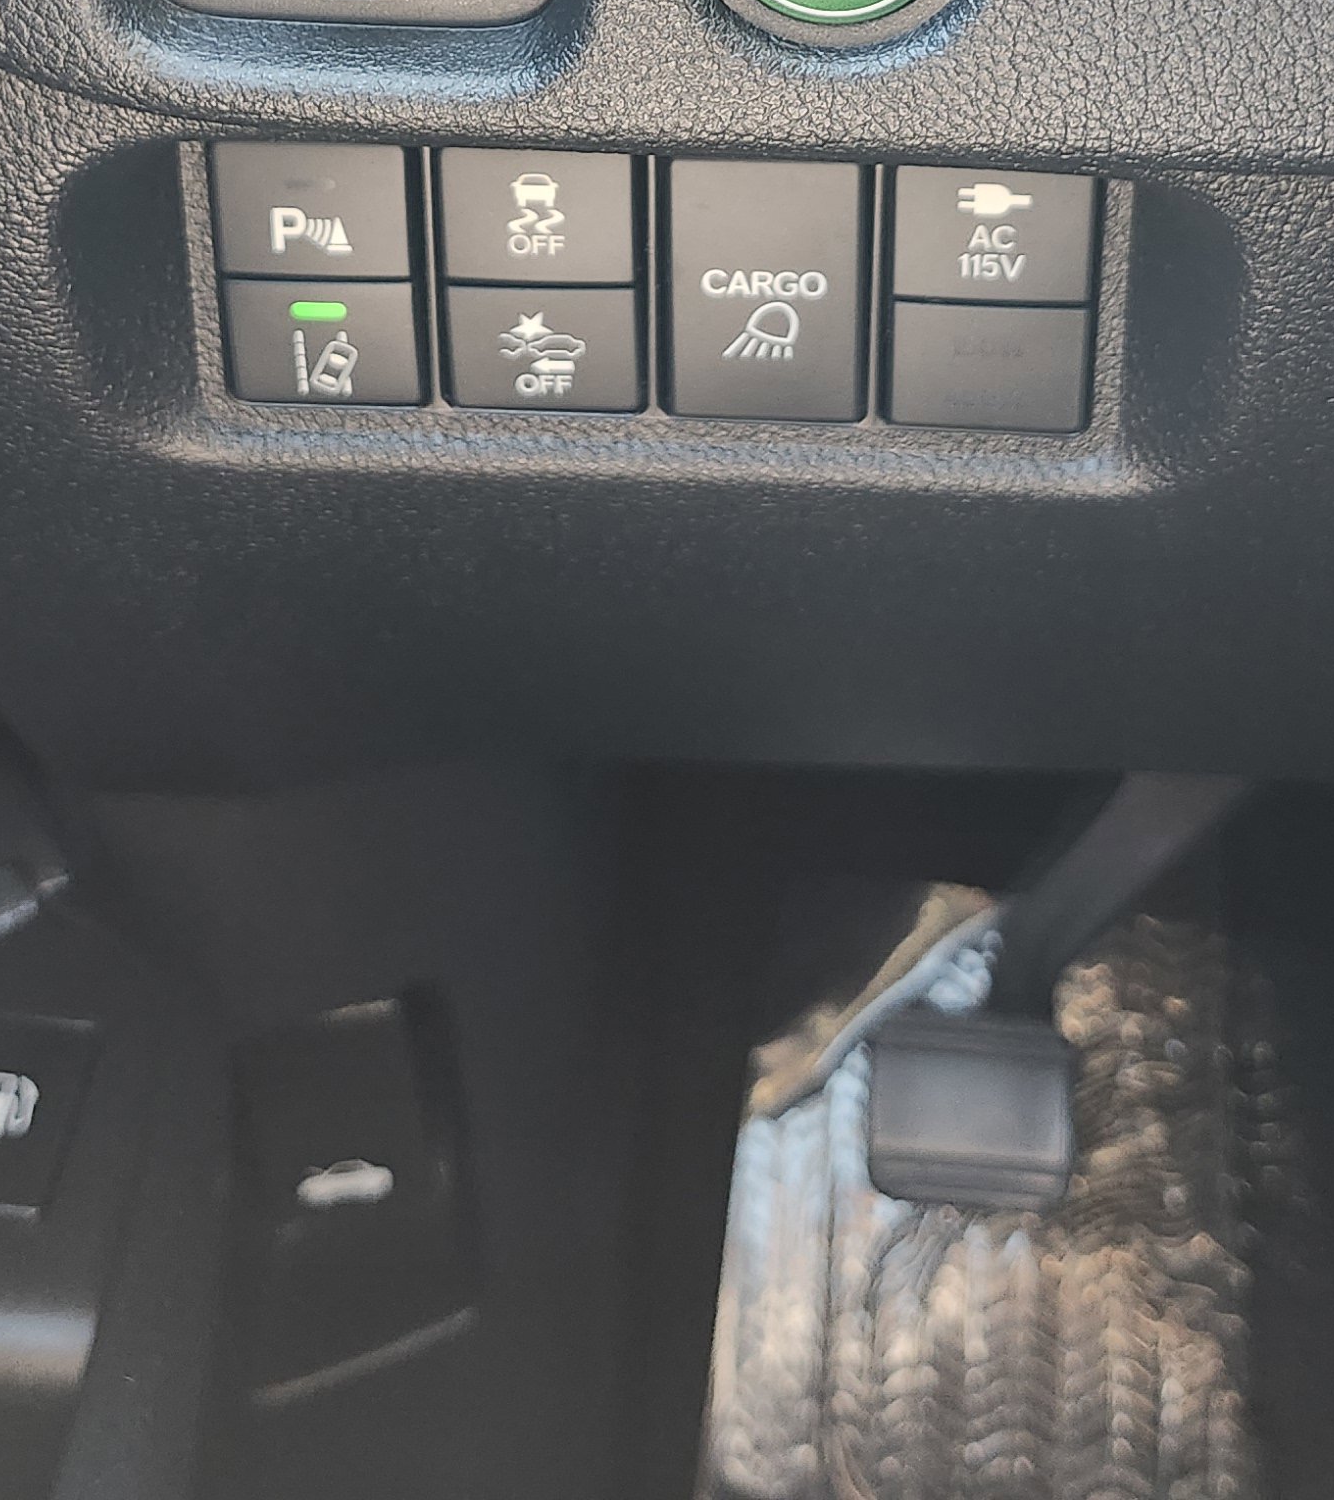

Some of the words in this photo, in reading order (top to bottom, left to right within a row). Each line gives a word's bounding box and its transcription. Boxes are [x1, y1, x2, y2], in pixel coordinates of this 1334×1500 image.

[507, 233, 566, 258] OFF
[967, 224, 1017, 252] AC
[957, 253, 1027, 281] 115V
[701, 269, 828, 299] CARGO
[514, 373, 574, 396] OFF
